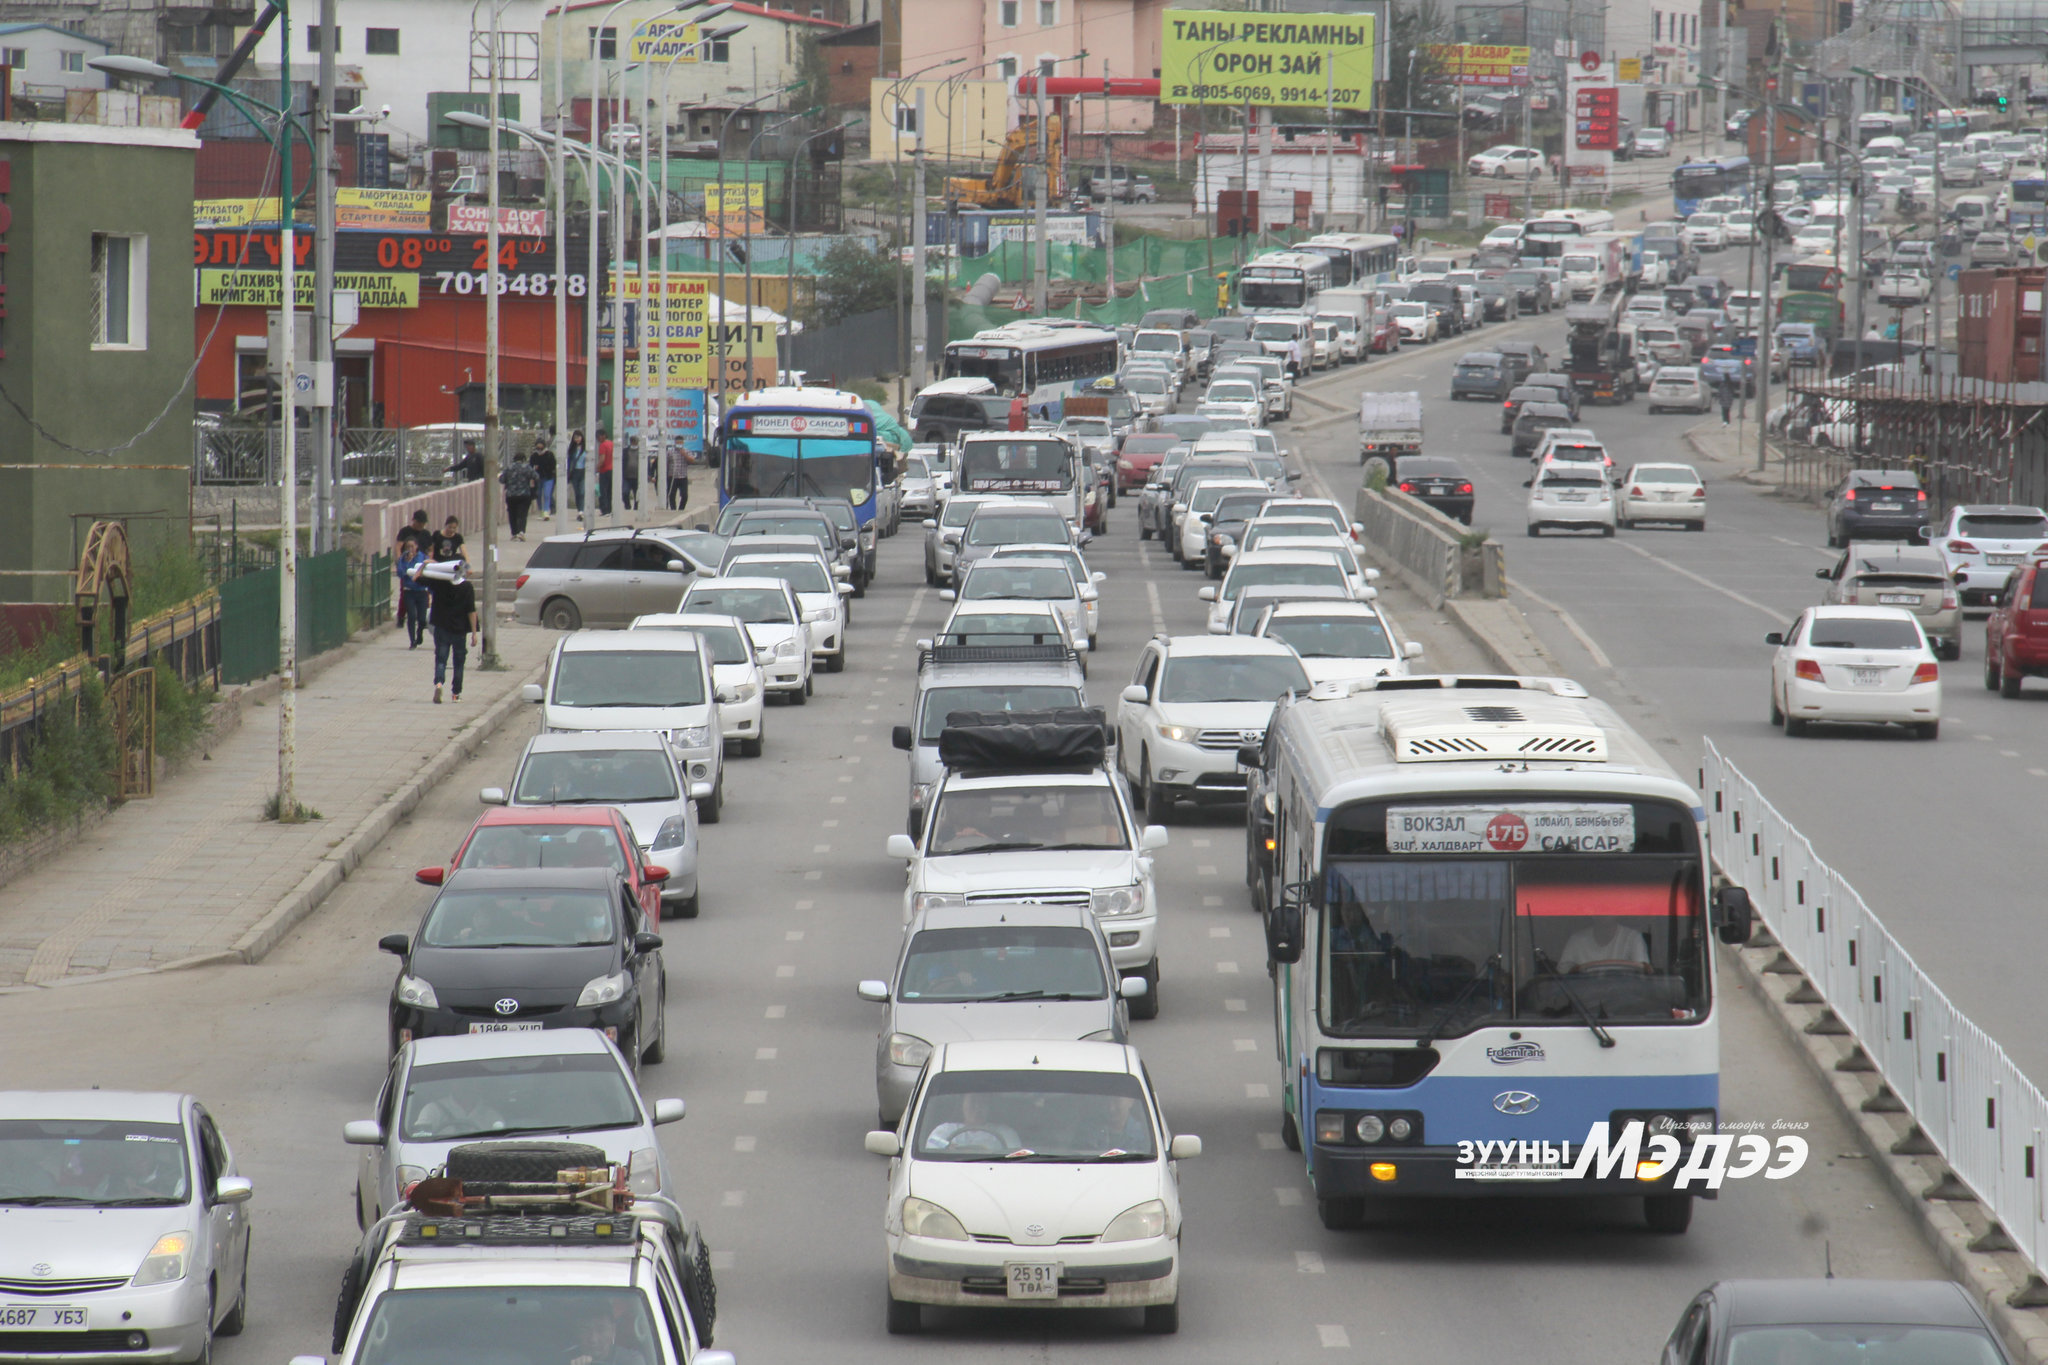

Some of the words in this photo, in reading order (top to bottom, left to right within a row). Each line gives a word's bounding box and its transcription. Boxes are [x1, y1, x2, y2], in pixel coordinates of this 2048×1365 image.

[648, 23, 684, 38] АВТО
[1173, 20, 1235, 41] ТАНЫ
[1242, 23, 1364, 45] РЕКЛАМНЫ
[637, 41, 695, 57] УГААЛГА
[1213, 53, 1272, 73] ОРОН
[1279, 51, 1321, 75] ЗАЙ
[1191, 85, 1275, 103] 8805-6069,
[1280, 87, 1360, 103] 9914-1207
[359, 191, 428, 202] АМОРТИЗАТОР
[372, 200, 415, 210] ХУДАЛДАА
[341, 212, 386, 222] СТАРТЕР
[388, 214, 426, 224] ЖАНАМ
[211, 288, 265, 303] НИМГЭН
[647, 325, 703, 338] ЗСВАР
[708, 378, 767, 391] ТСЛ
[755, 418, 789, 428] МОНЕЛ
[809, 419, 846, 429] САНСАР
[1403, 816, 1465, 832] ВОКЗАЛ
[1488, 825, 1526, 842] 17Б
[1534, 816, 1573, 829] 100АЙЛ,
[1421, 841, 1484, 851] ХАЛДВАРТ
[1541, 835, 1620, 851] САНСАР
[1486, 1047, 1545, 1057] ErdemTrans
[1014, 1266, 1051, 1281] 2591
